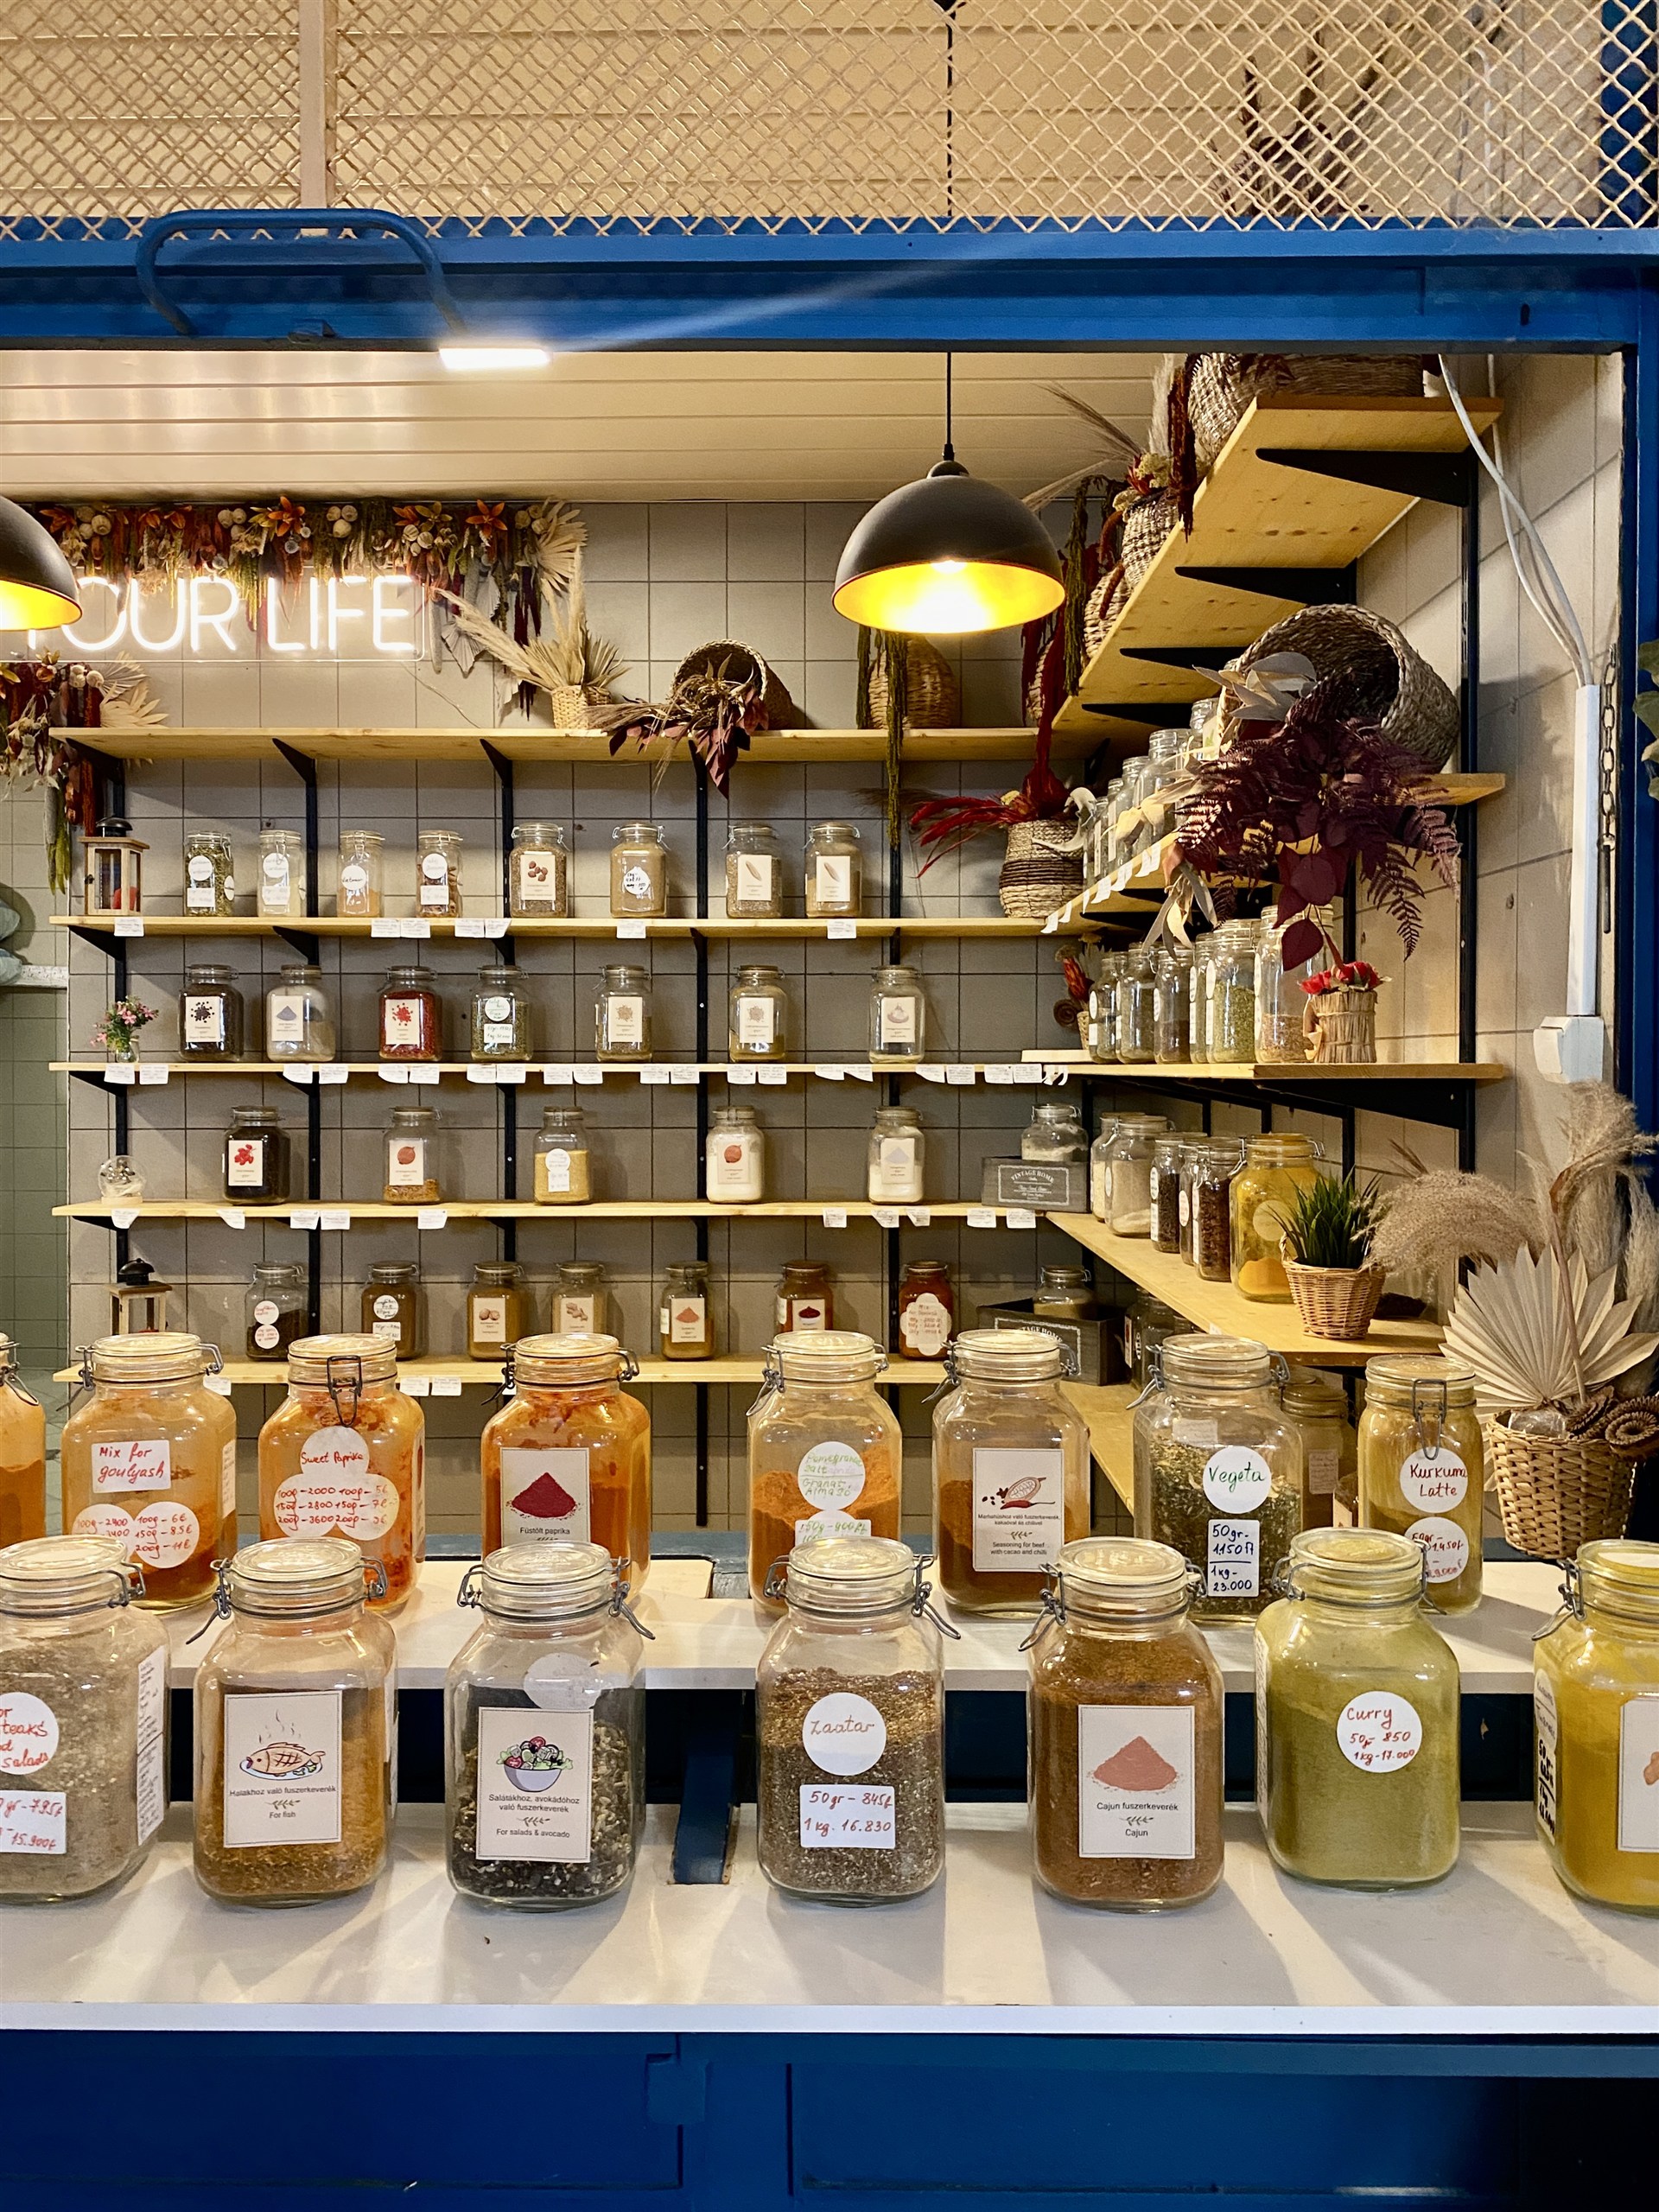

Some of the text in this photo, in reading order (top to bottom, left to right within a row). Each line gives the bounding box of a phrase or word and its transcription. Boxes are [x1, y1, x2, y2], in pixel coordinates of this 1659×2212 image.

[29, 575, 415, 651] OUR LIFE
[99, 1443, 152, 1462] Mix for
[301, 1452, 329, 1465] Sweet
[98, 1460, 164, 1484] goulyash
[1209, 1461, 1266, 1493] Vegeta
[1410, 1463, 1468, 1478] Kurkuma
[1420, 1483, 1458, 1497] Latte
[1213, 1580, 1252, 1592] 23.000
[810, 1714, 875, 1735] Zaatar
[1347, 1707, 1392, 1730] Curry
[1382, 1732, 1411, 1742] 850
[535, 1796, 580, 1804] avokádóhoz
[1096, 1802, 1120, 1811] Cajun
[842, 1819, 892, 1832] 16.830
[1125, 1828, 1148, 1838] Cajun
